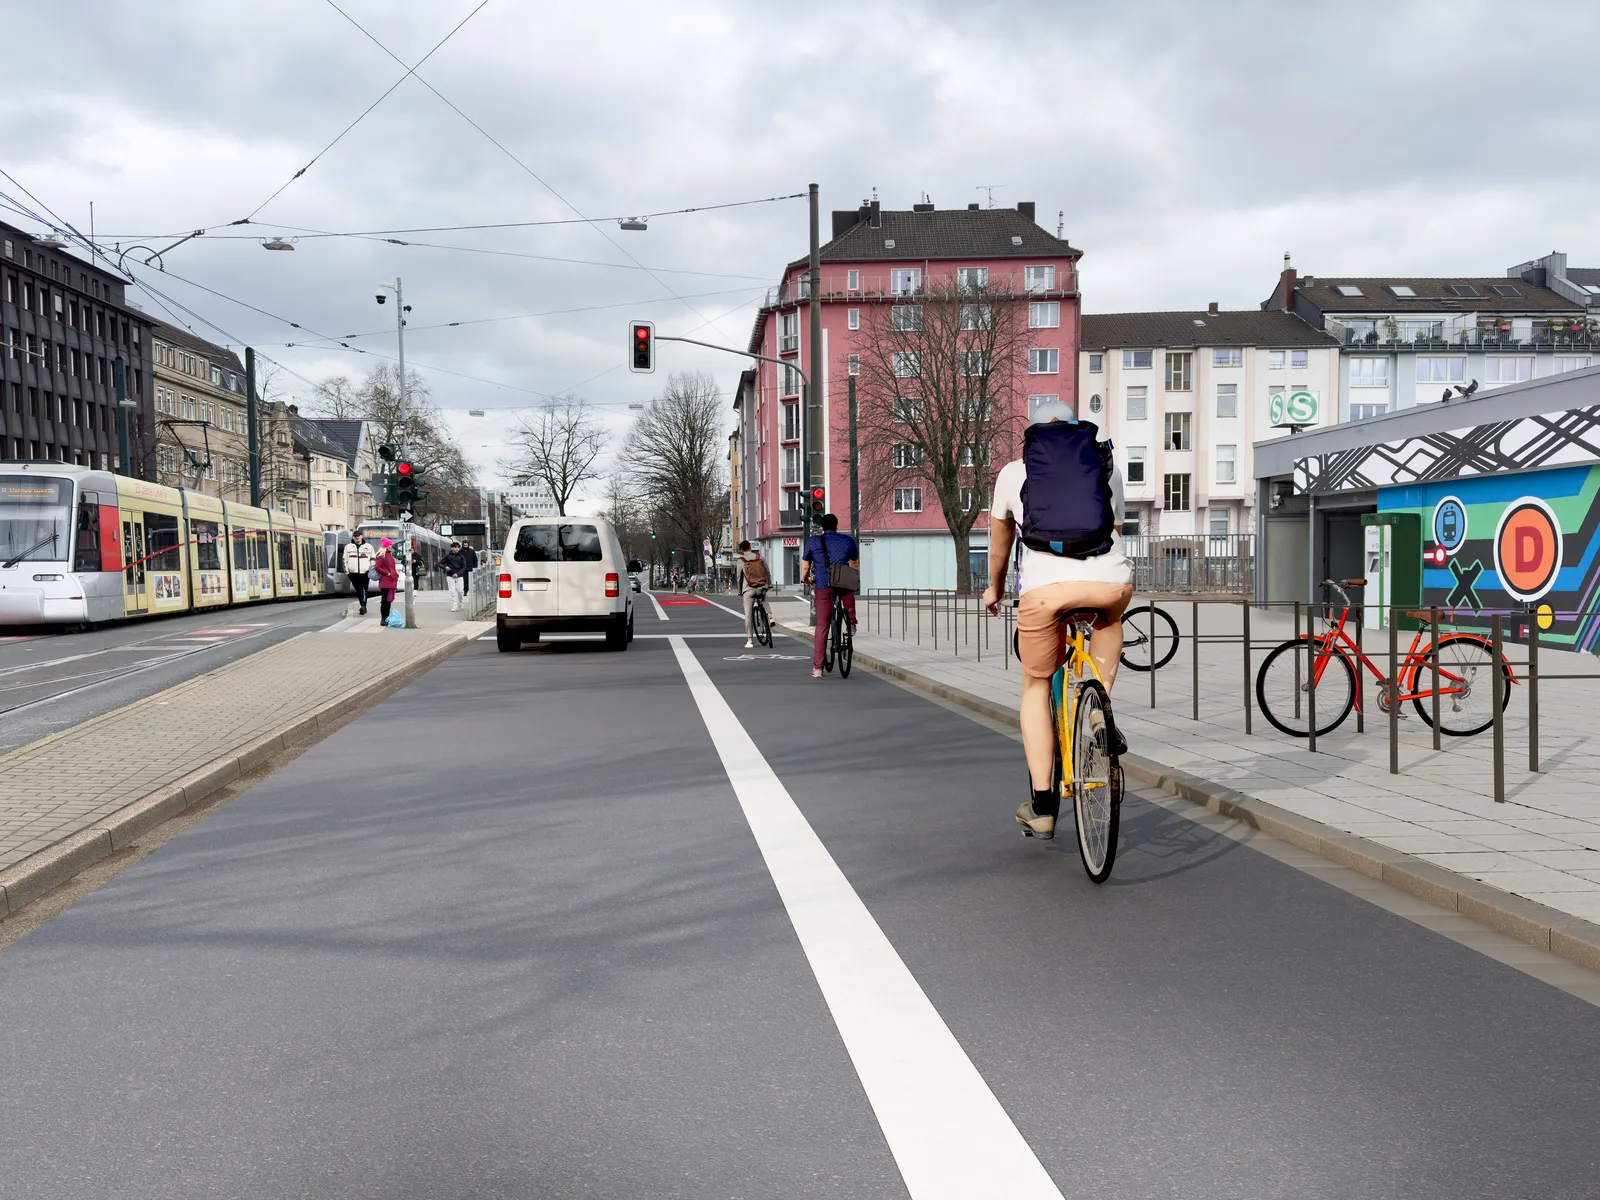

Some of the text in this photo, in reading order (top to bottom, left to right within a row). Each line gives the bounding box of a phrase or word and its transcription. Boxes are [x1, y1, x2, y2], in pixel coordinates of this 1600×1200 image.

[1272, 397, 1281, 422] S
[1292, 394, 1313, 420] S
[783, 538, 799, 547] KIOSK
[1515, 526, 1544, 573] D
